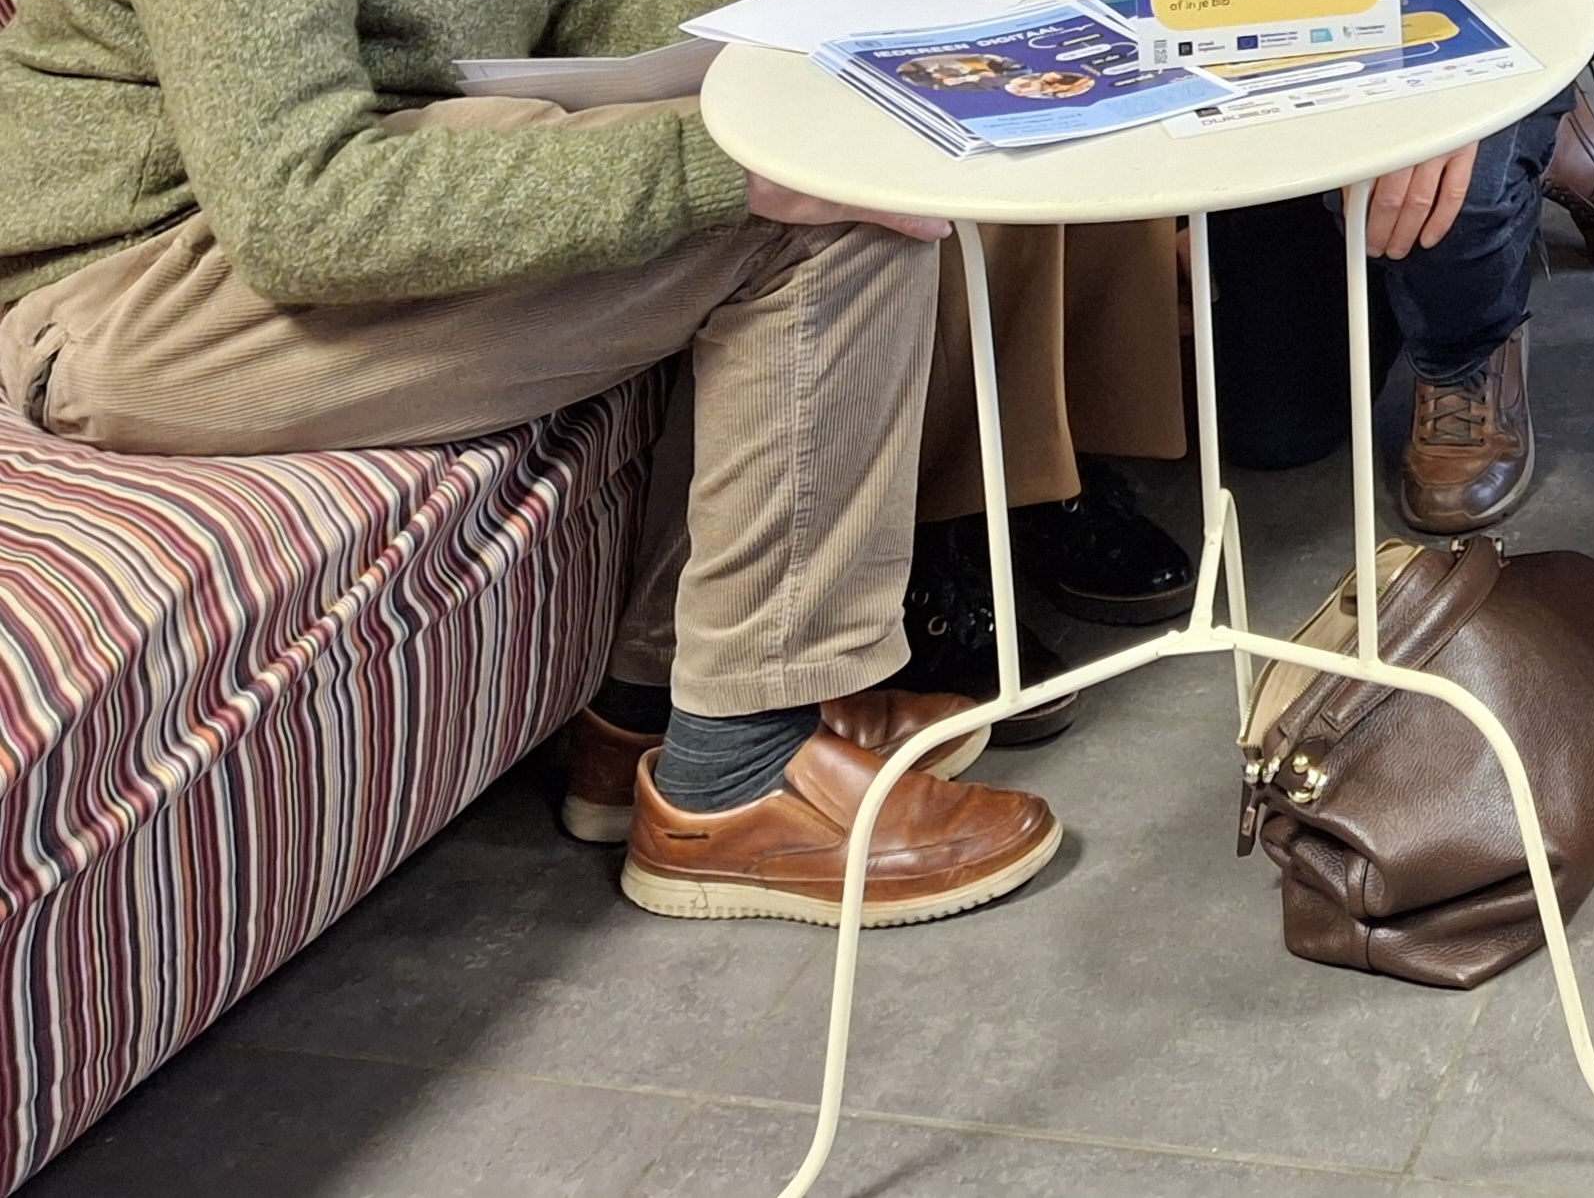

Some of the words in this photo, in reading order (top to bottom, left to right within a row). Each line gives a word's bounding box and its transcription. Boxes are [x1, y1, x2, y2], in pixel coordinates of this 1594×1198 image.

[1170, 0, 1184, 11] of
[873, 41, 970, 59] IEDEREEN
[976, 25, 1065, 48] DIGITAAL
